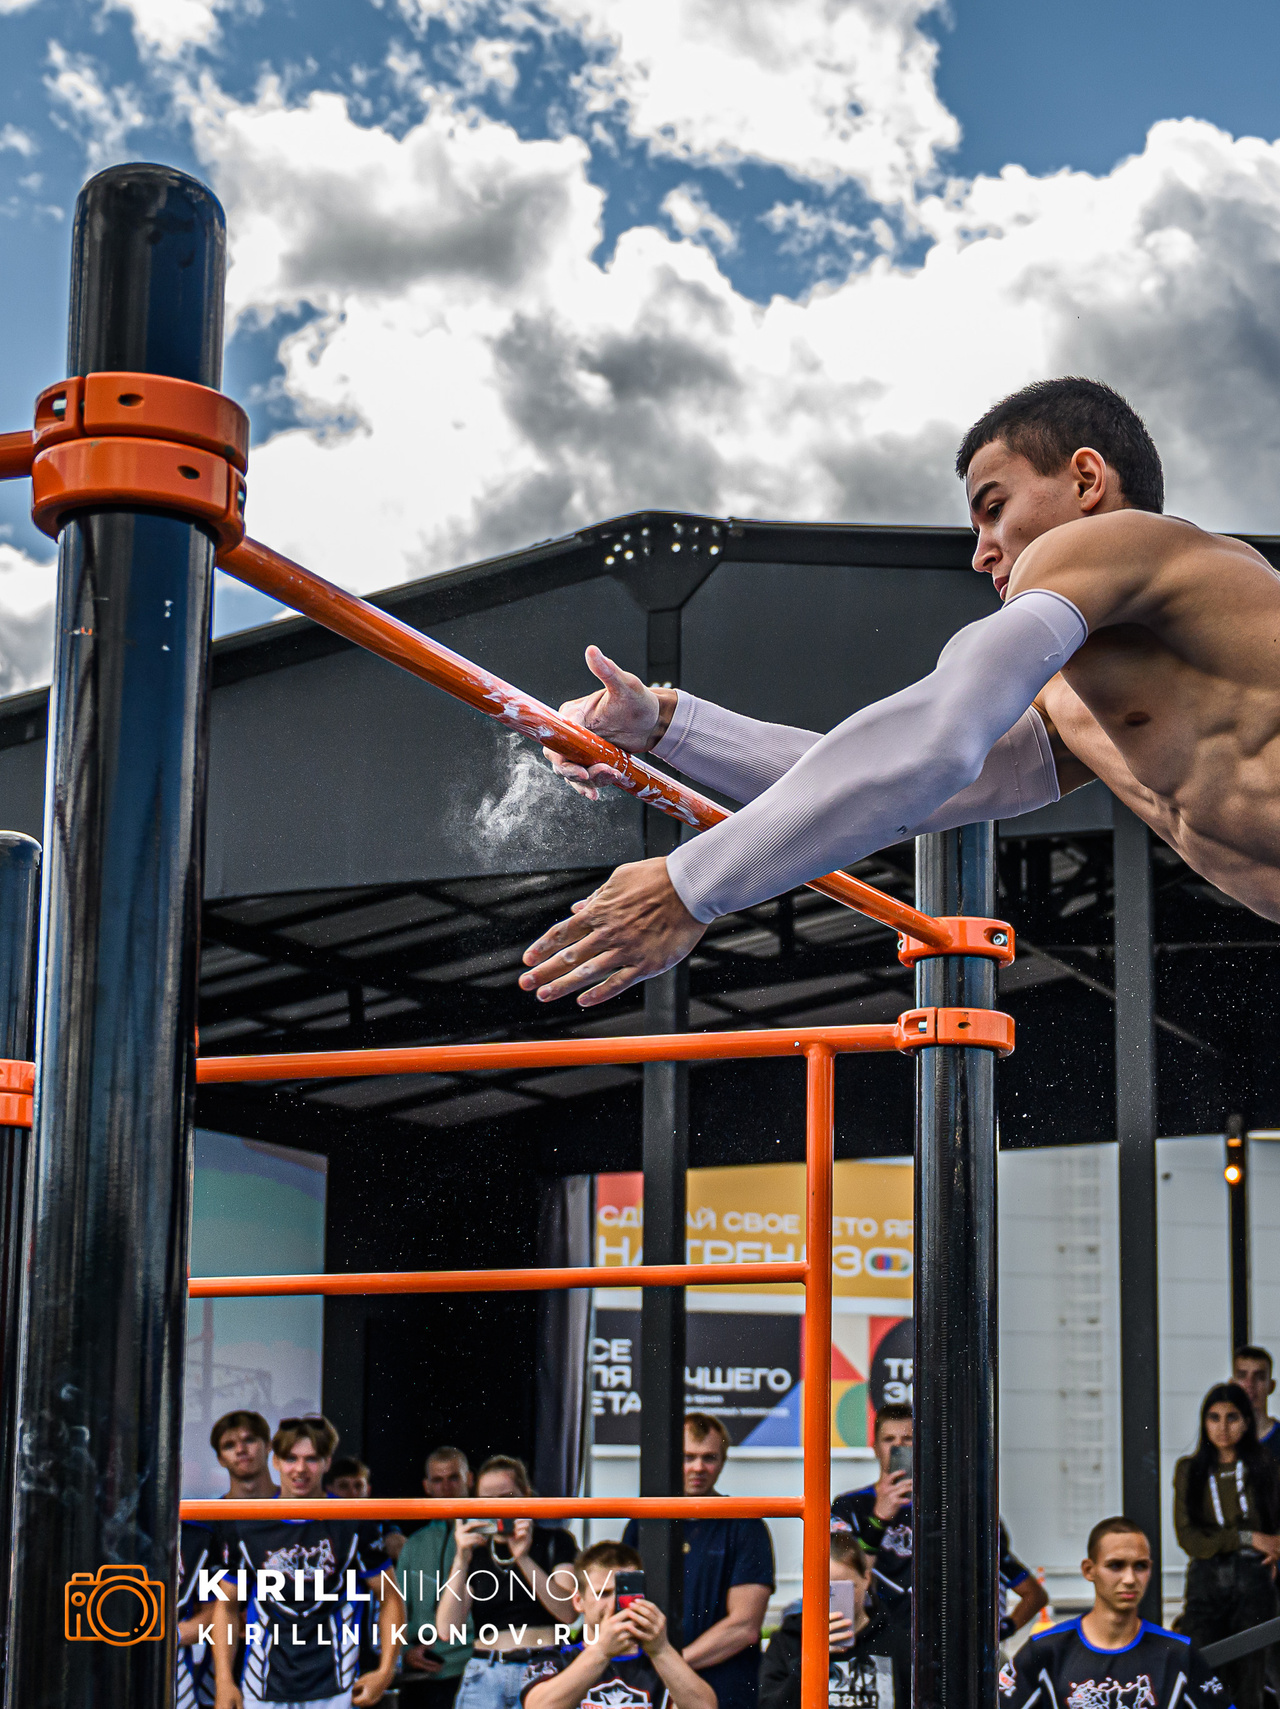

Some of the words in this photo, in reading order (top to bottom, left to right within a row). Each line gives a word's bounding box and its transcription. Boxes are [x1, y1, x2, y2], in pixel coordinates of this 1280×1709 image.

[723, 1210, 800, 1234] СВОЕ
[833, 1216, 878, 1238] ЕТО
[591, 1337, 633, 1363] СЕ
[684, 1366, 792, 1392] ЧШЕГО
[591, 1390, 642, 1415] ЕТА
